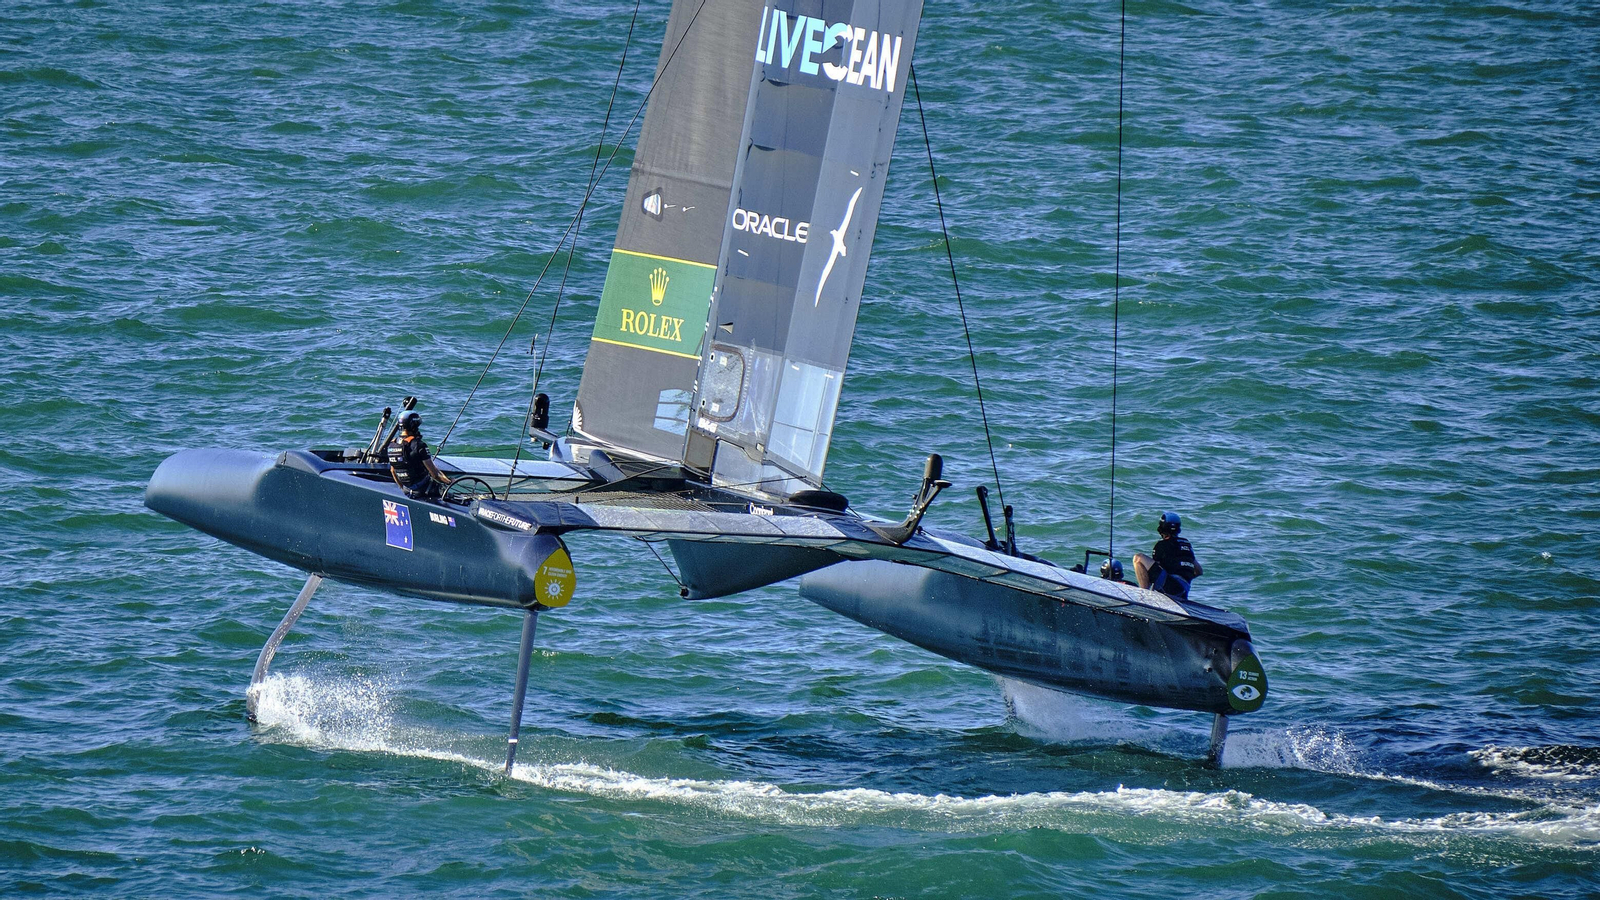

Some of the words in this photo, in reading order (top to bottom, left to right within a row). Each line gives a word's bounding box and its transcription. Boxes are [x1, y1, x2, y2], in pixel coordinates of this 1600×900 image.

[732, 208, 810, 243] ORACLE
[620, 308, 684, 342] ROLEX
[543, 566, 548, 575] 7
[1239, 670, 1248, 680] 13
